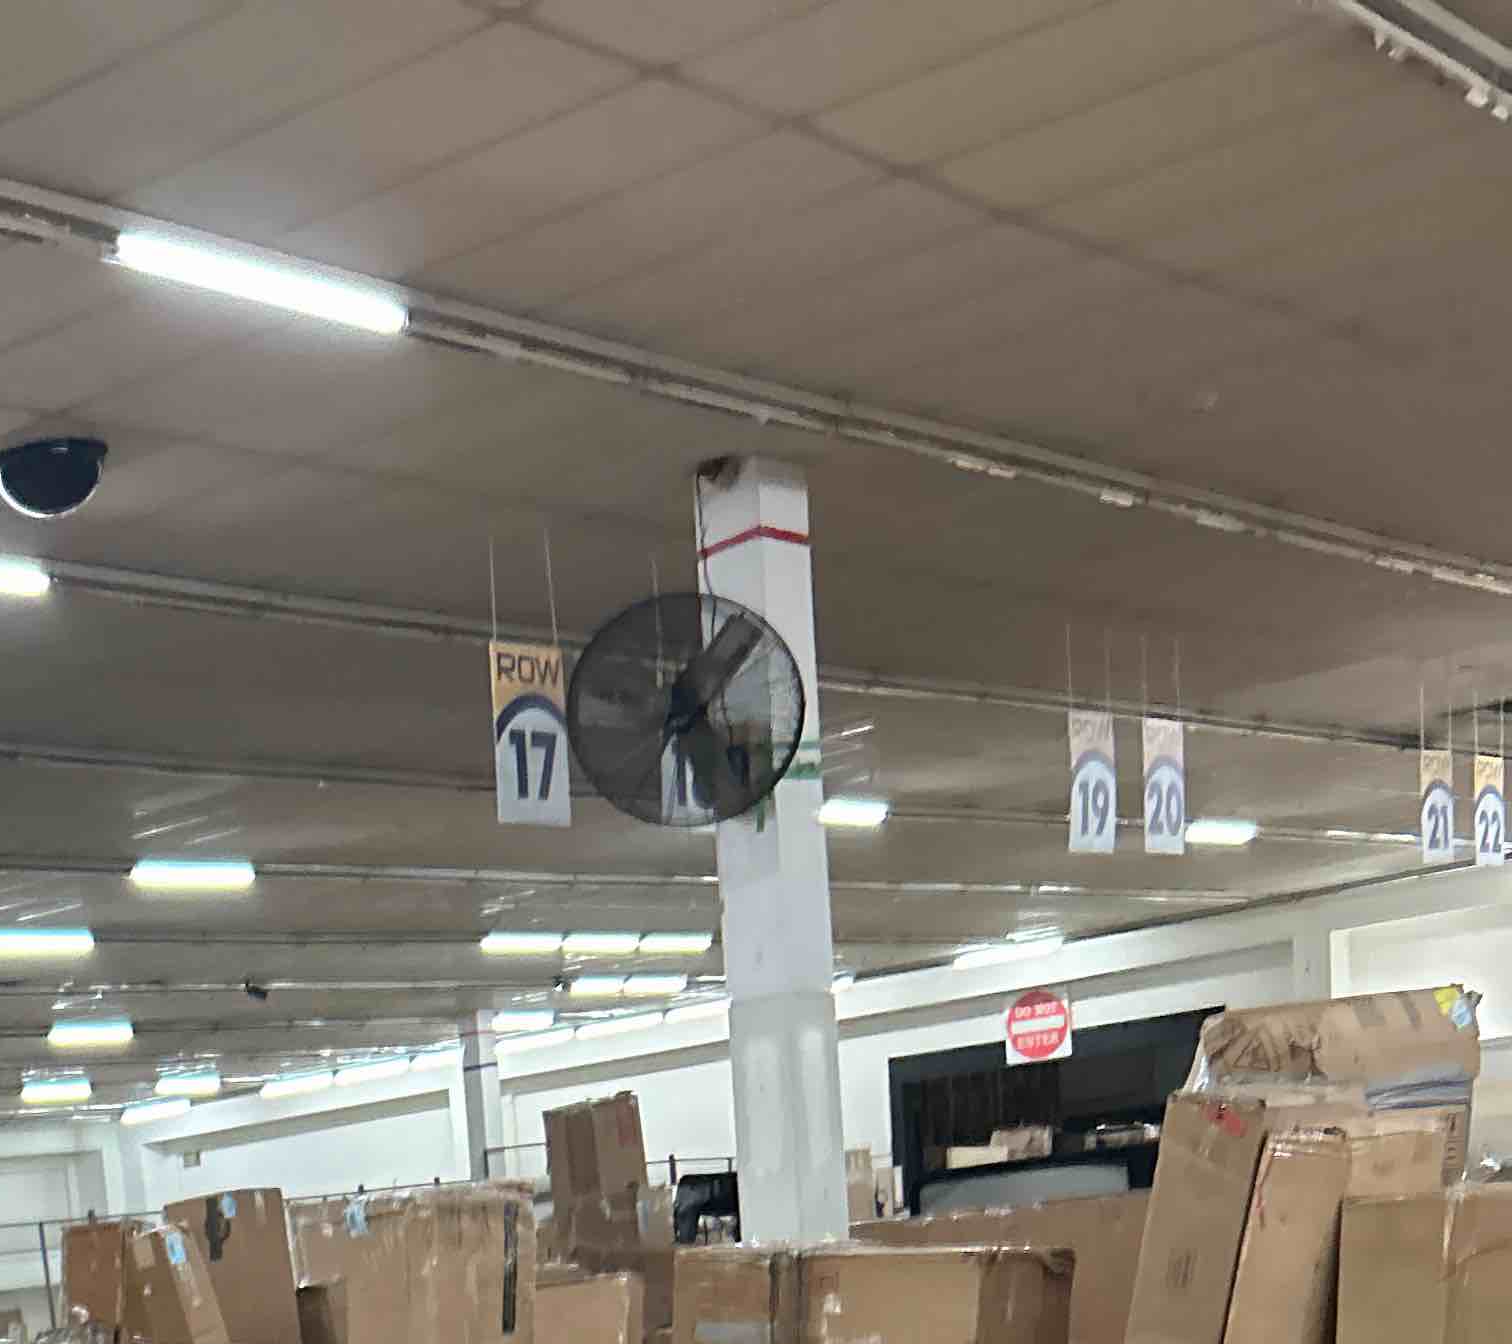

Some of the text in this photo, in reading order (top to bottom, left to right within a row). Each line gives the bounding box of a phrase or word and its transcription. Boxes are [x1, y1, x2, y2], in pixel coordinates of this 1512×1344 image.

[496, 652, 562, 688] ROW
[509, 729, 557, 800] 17
[1079, 780, 1109, 836] 19
[1148, 781, 1181, 836] 20
[1428, 804, 1448, 848] 21
[1479, 810, 1501, 853] 22
